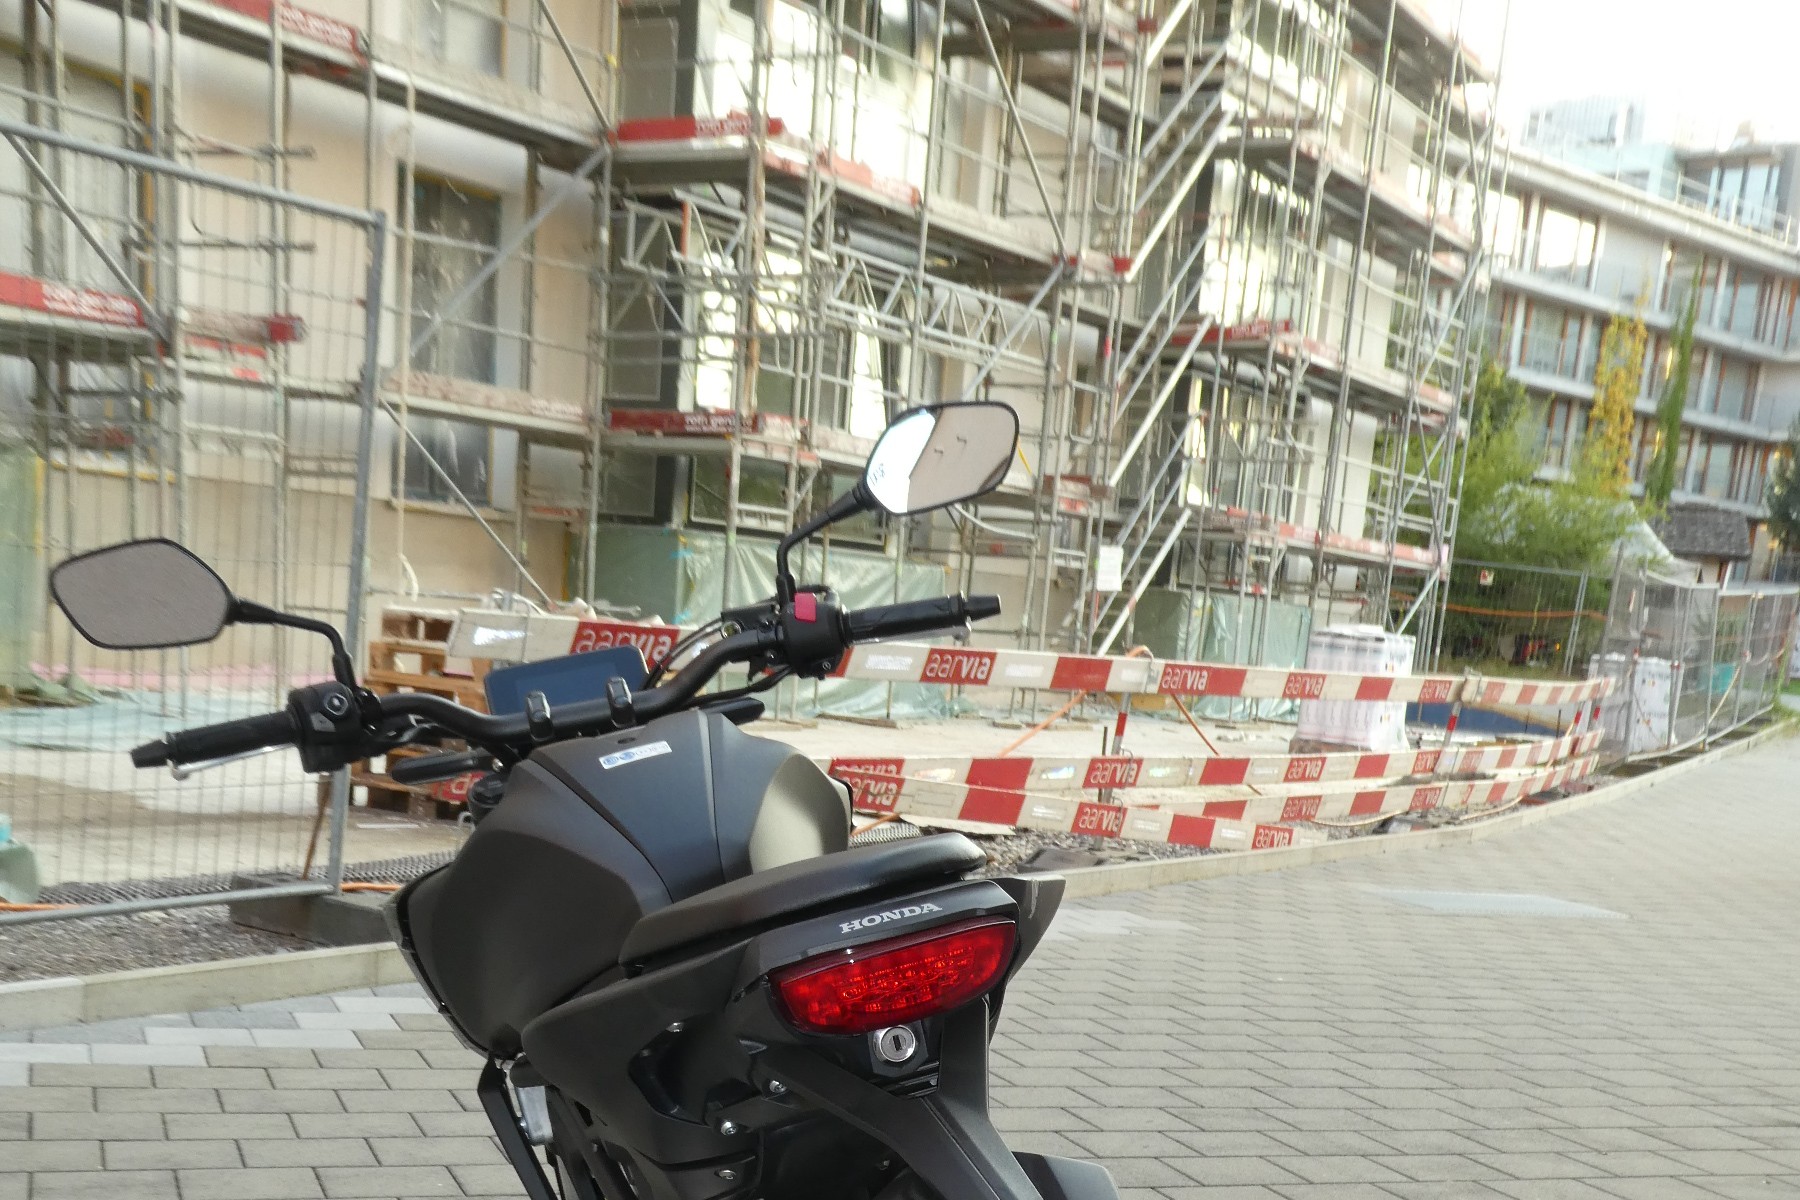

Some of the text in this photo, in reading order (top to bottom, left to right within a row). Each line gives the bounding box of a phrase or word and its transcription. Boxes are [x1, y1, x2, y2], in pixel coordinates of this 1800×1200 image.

[925, 653, 991, 680] aarvia
[1162, 667, 1208, 691] aarvia
[1285, 676, 1324, 697] aarvia
[1090, 762, 1138, 784] aarvia
[1288, 759, 1322, 780] aarvia
[1079, 807, 1123, 832] aarvia
[1283, 799, 1318, 818] aarvia
[1255, 828, 1290, 848] aarvia
[839, 903, 943, 934] HONDA
